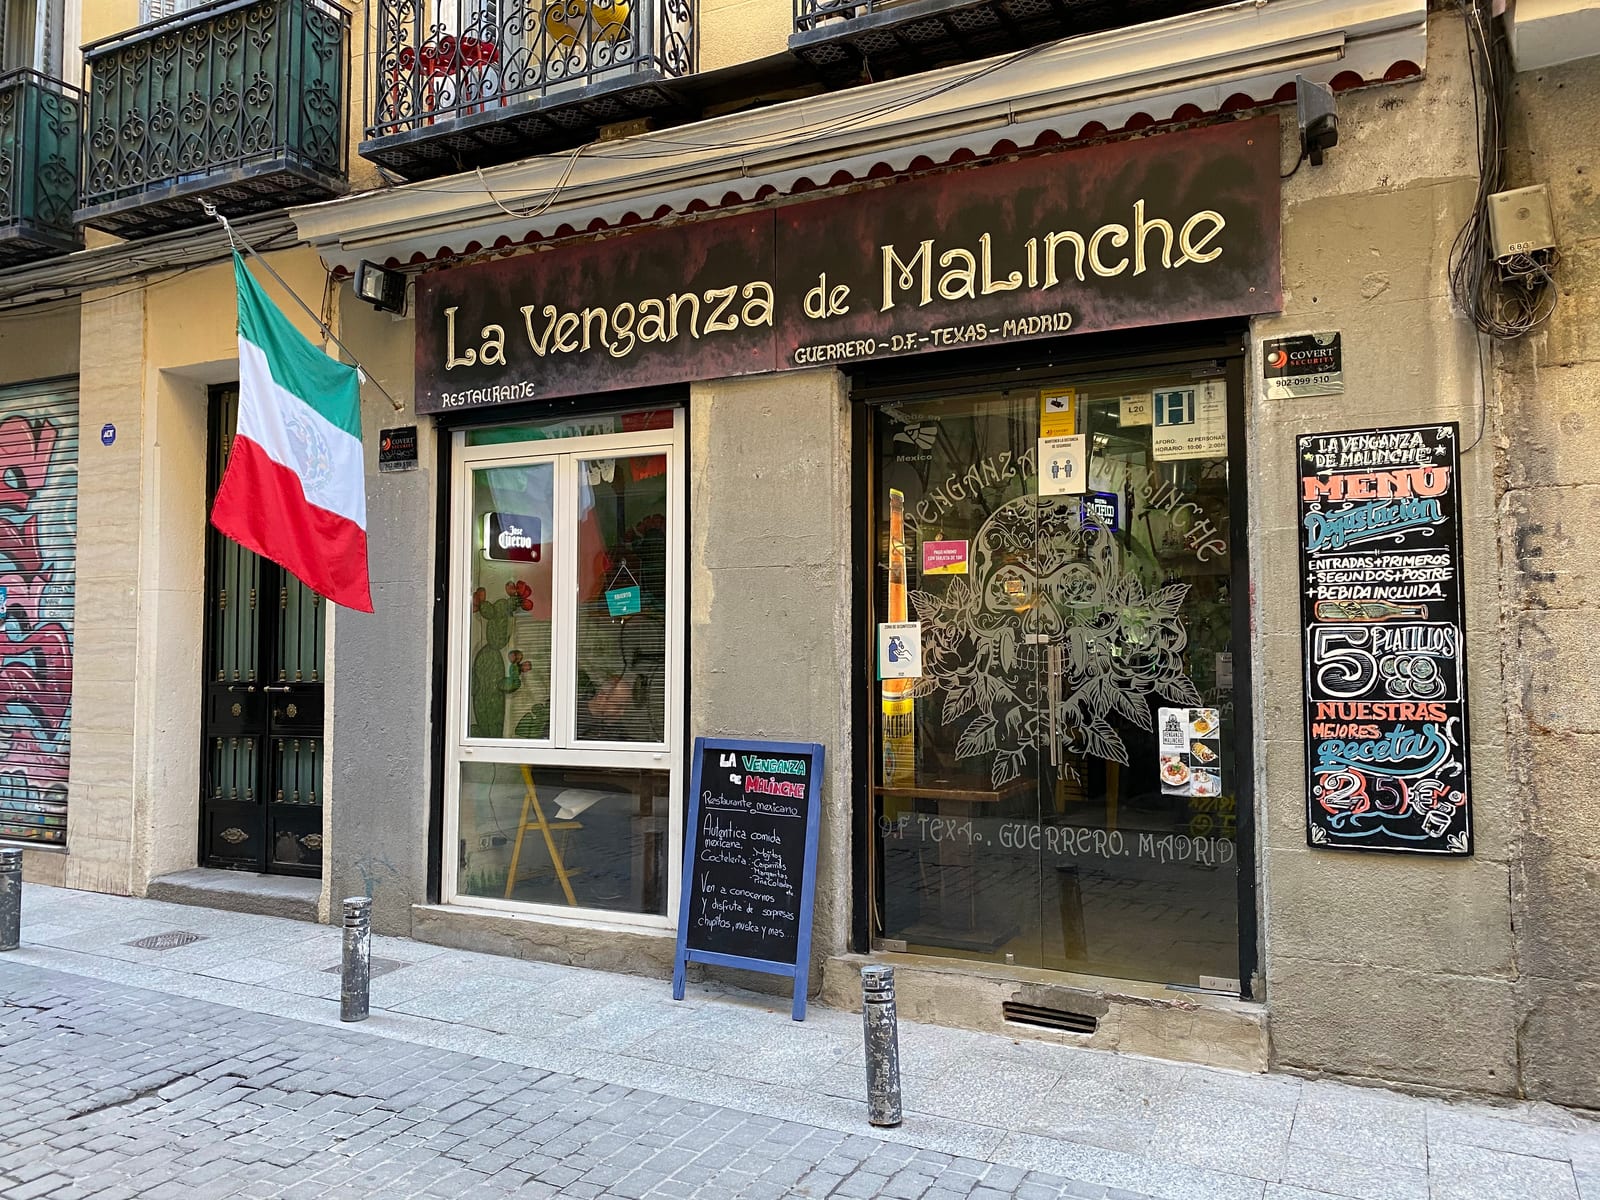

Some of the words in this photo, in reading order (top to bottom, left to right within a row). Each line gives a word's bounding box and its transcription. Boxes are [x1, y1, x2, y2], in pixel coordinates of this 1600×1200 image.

[445, 306, 506, 370] La
[520, 281, 775, 358] Venganza
[803, 272, 850, 319] de
[794, 338, 876, 364] GUERRERO
[930, 323, 988, 347] TEXAS
[1002, 312, 1073, 337] MADRID
[1290, 348, 1334, 360] COVERT
[1290, 357, 1335, 366] SECURITY
[1276, 379, 1292, 388] 902
[1294, 377, 1311, 386] 099
[1313, 375, 1330, 384] 510
[441, 381, 536, 408] RESTAURANTE
[1128, 405, 1144, 413] L20
[1318, 438, 1338, 454] LA
[1341, 432, 1425, 451] VENGANZA
[896, 454, 933, 463] Mexico
[1315, 453, 1338, 468] DE
[1339, 446, 1433, 468] MALINCHE
[498, 530, 532, 549] Cuervo
[508, 525, 523, 536] Jose
[1314, 627, 1378, 698] 5
[1371, 626, 1455, 656] PLATILLOS
[1315, 702, 1448, 723] NUESTRAS
[1312, 723, 1381, 740] MEJORES
[720, 753, 737, 768] LA
[742, 755, 806, 776] VENGANZA
[703, 790, 752, 808] Restaurante
[756, 802, 798, 816] mexicano
[750, 828, 781, 845] comida
[1138, 833, 1234, 866] MADRID
[701, 871, 715, 893] Ven
[720, 887, 727, 895] a
[730, 888, 775, 903] conocernos
[746, 903, 754, 914] de
